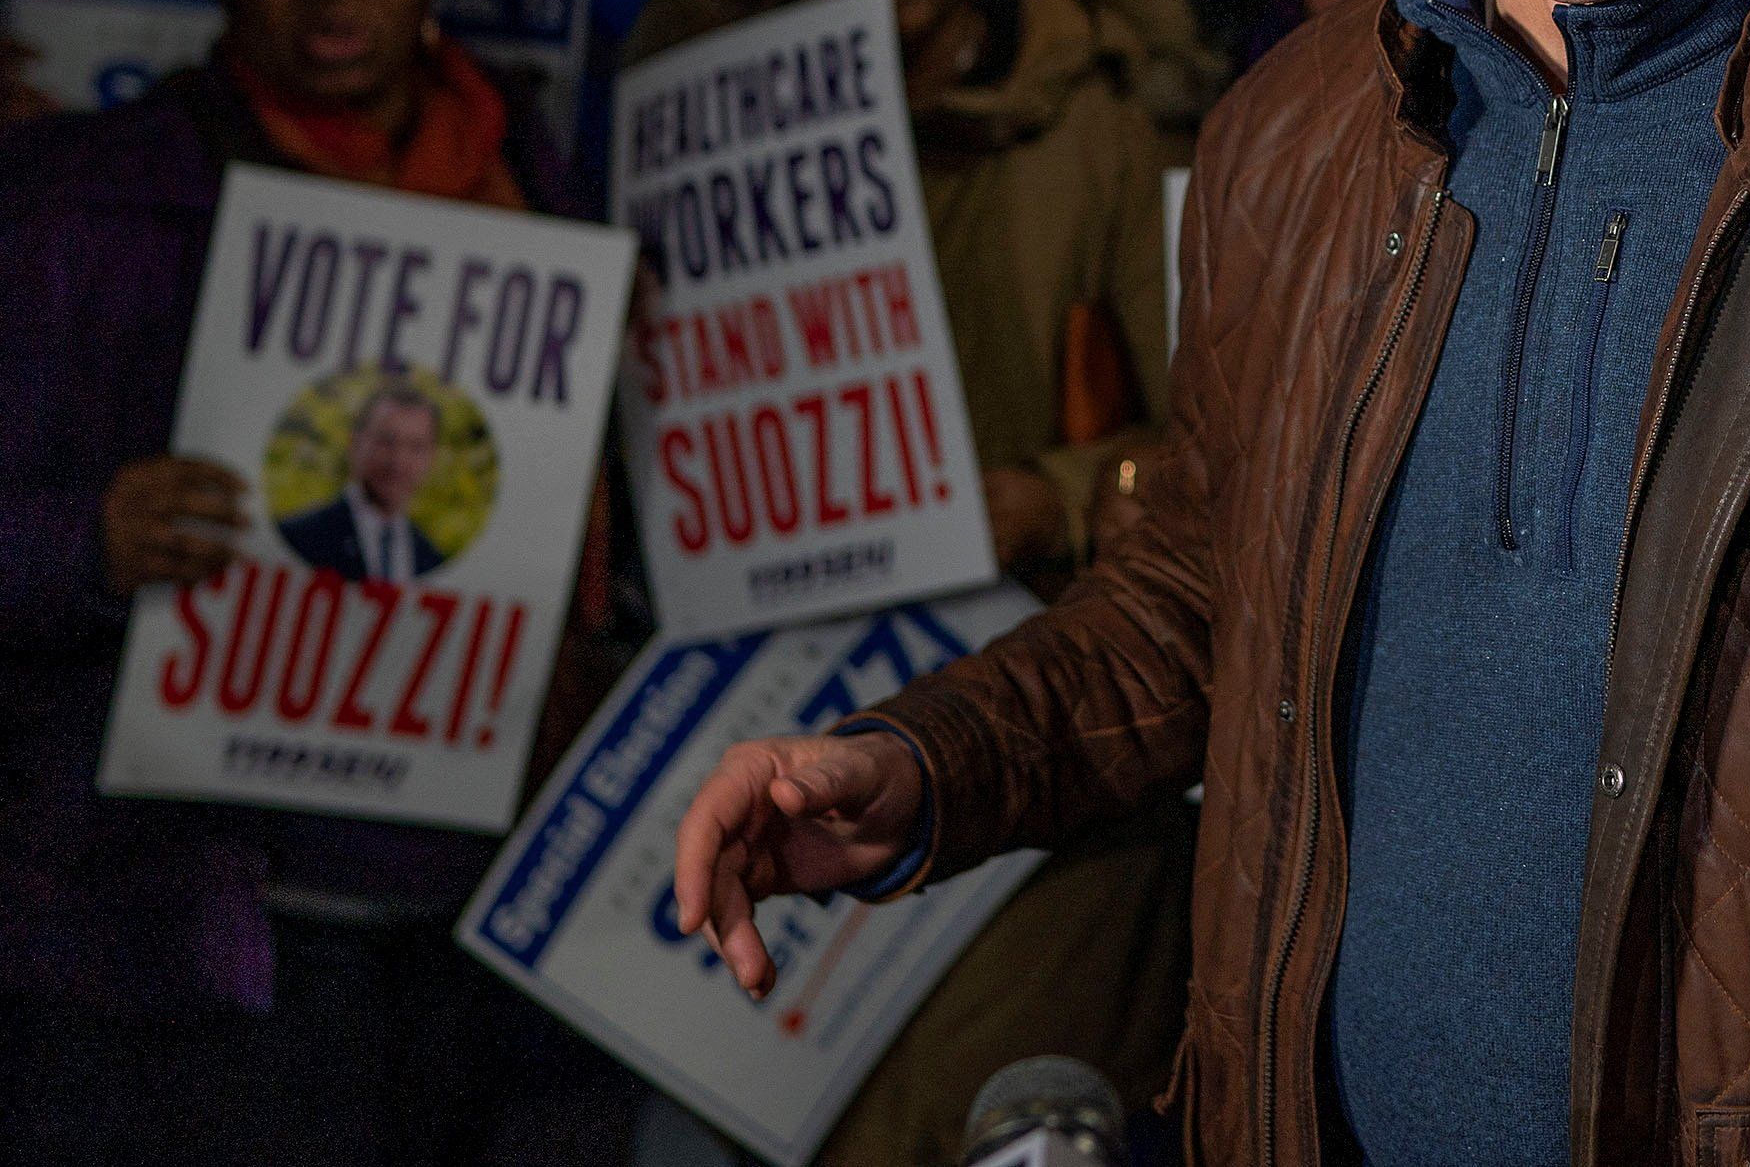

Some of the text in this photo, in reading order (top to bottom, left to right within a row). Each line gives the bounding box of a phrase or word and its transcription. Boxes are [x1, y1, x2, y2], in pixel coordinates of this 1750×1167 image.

[632, 31, 878, 175] HEALTHCARE
[630, 133, 899, 291] WORKERS
[246, 219, 584, 404] VOTE FOR
[638, 261, 923, 404] STAND WITH
[658, 369, 952, 553] SUOZZI!
[161, 560, 522, 748] SUOZZI!
[485, 789, 608, 954] Special
[580, 644, 722, 812] Election
